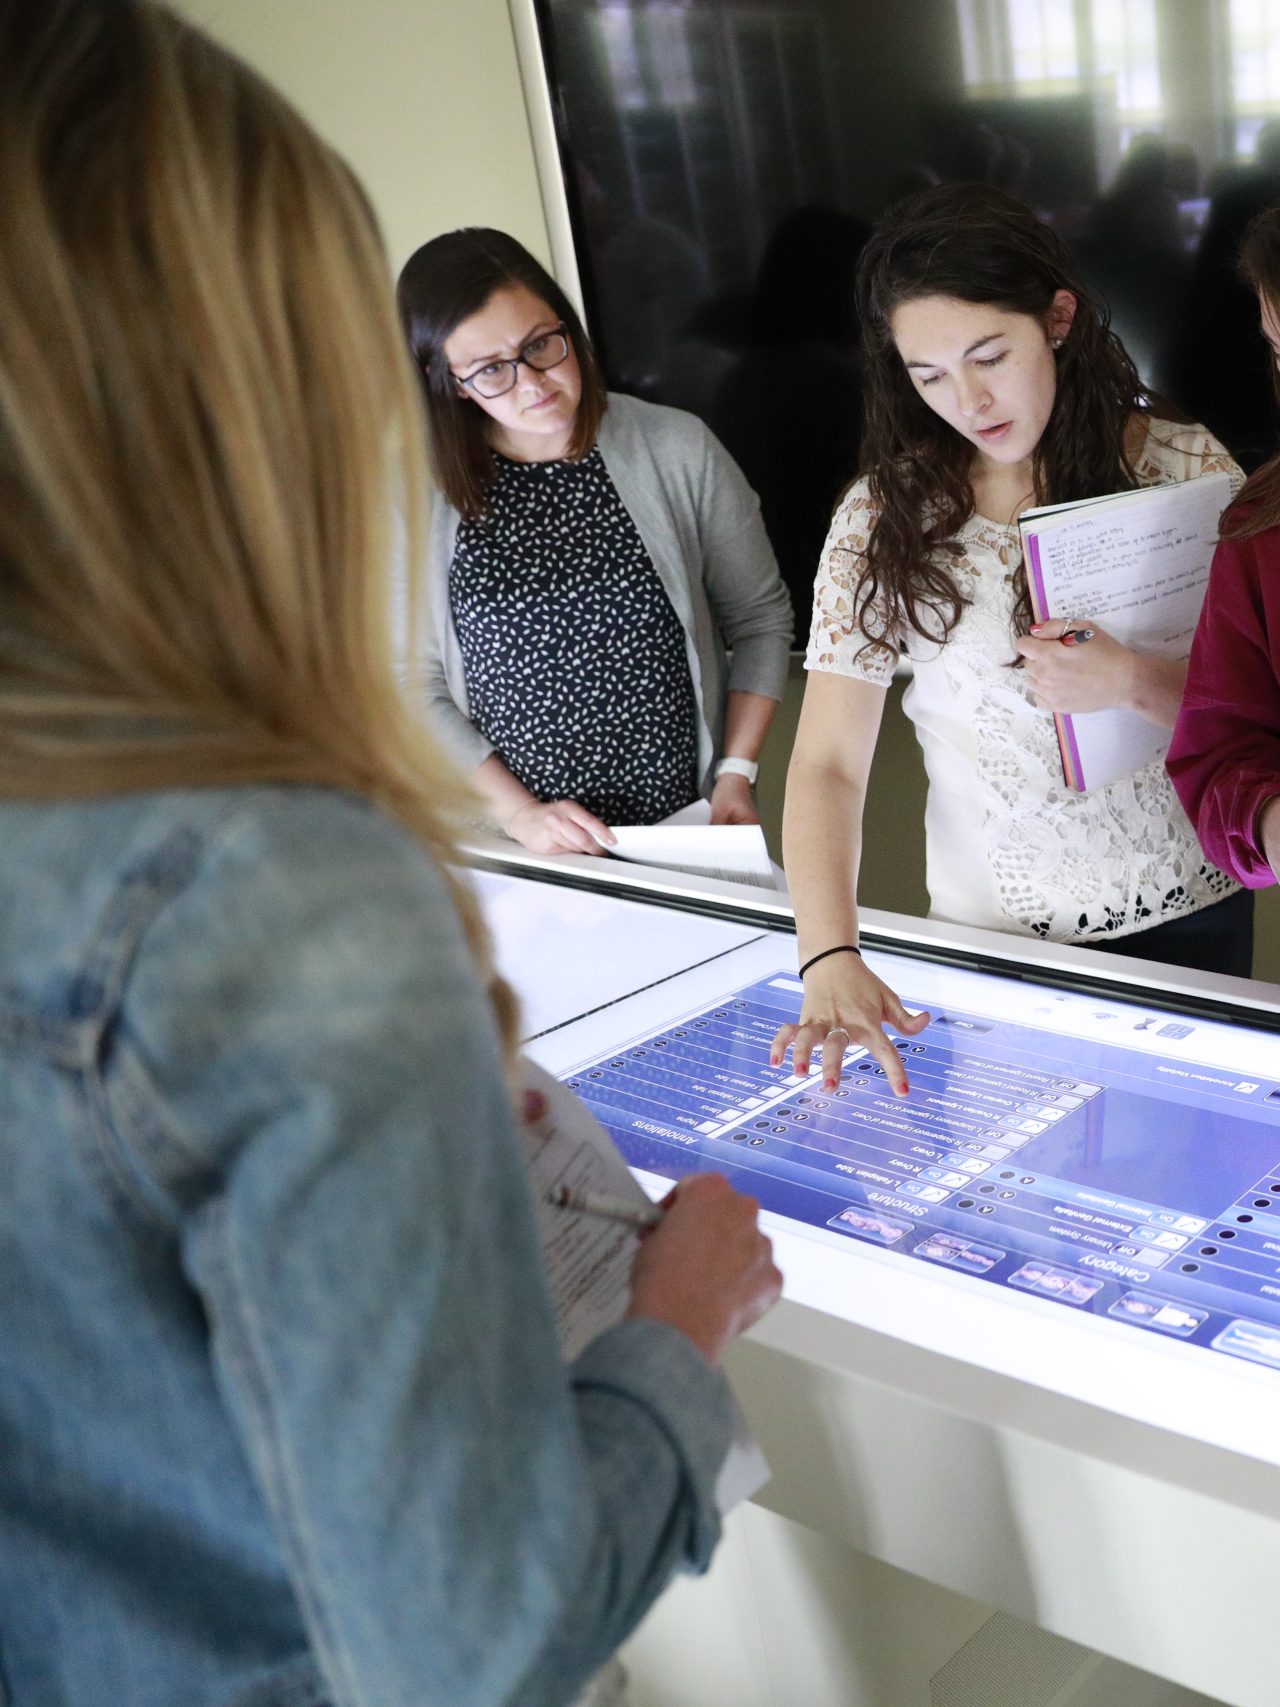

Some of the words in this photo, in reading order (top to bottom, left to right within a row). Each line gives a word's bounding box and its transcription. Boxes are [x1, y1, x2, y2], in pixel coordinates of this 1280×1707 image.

[759, 1070, 779, 1078] Ovary
[944, 1070, 966, 1079] Uterus
[1155, 1066, 1188, 1076] Visibility
[730, 1078, 760, 1090] Fallopian
[974, 1076, 1007, 1089] Ligament
[1026, 1074, 1050, 1082] Round
[1190, 1074, 1235, 1087] Annotation
[692, 1084, 708, 1092] Tube
[946, 1086, 984, 1100] Ligament
[1006, 1084, 1030, 1094] Round
[708, 1089, 736, 1101] Fallopian
[984, 1094, 1012, 1106] Ovarian
[873, 1100, 893, 1109] Ovary
[926, 1098, 962, 1111] Ligament
[851, 1111, 872, 1120] Ovary
[901, 1107, 934, 1120] Ligament
[962, 1106, 992, 1118] Ovarian
[676, 1116, 699, 1127] Vagina
[880, 1119, 914, 1132] Ligament
[934, 1115, 976, 1130] Suspensory
[632, 1120, 699, 1144] Annotations
[912, 1128, 955, 1143] Suspensory
[987, 1130, 1001, 1138] Off
[910, 1146, 935, 1156] Ovary
[836, 1164, 855, 1173] Tube
[888, 1159, 913, 1170] Ovary
[858, 1170, 894, 1184] Fallopian
[867, 1192, 928, 1216] Structure
[1077, 1192, 1116, 1207] Genitalia
[1054, 1206, 1093, 1221] Genitalia
[1116, 1203, 1152, 1216] Internal
[1093, 1217, 1133, 1232] External
[1048, 1225, 1081, 1239] System
[1141, 1230, 1155, 1238] On
[1081, 1234, 1112, 1248] Urinary
[1116, 1246, 1135, 1256] Off
[1078, 1254, 1150, 1282] Category
